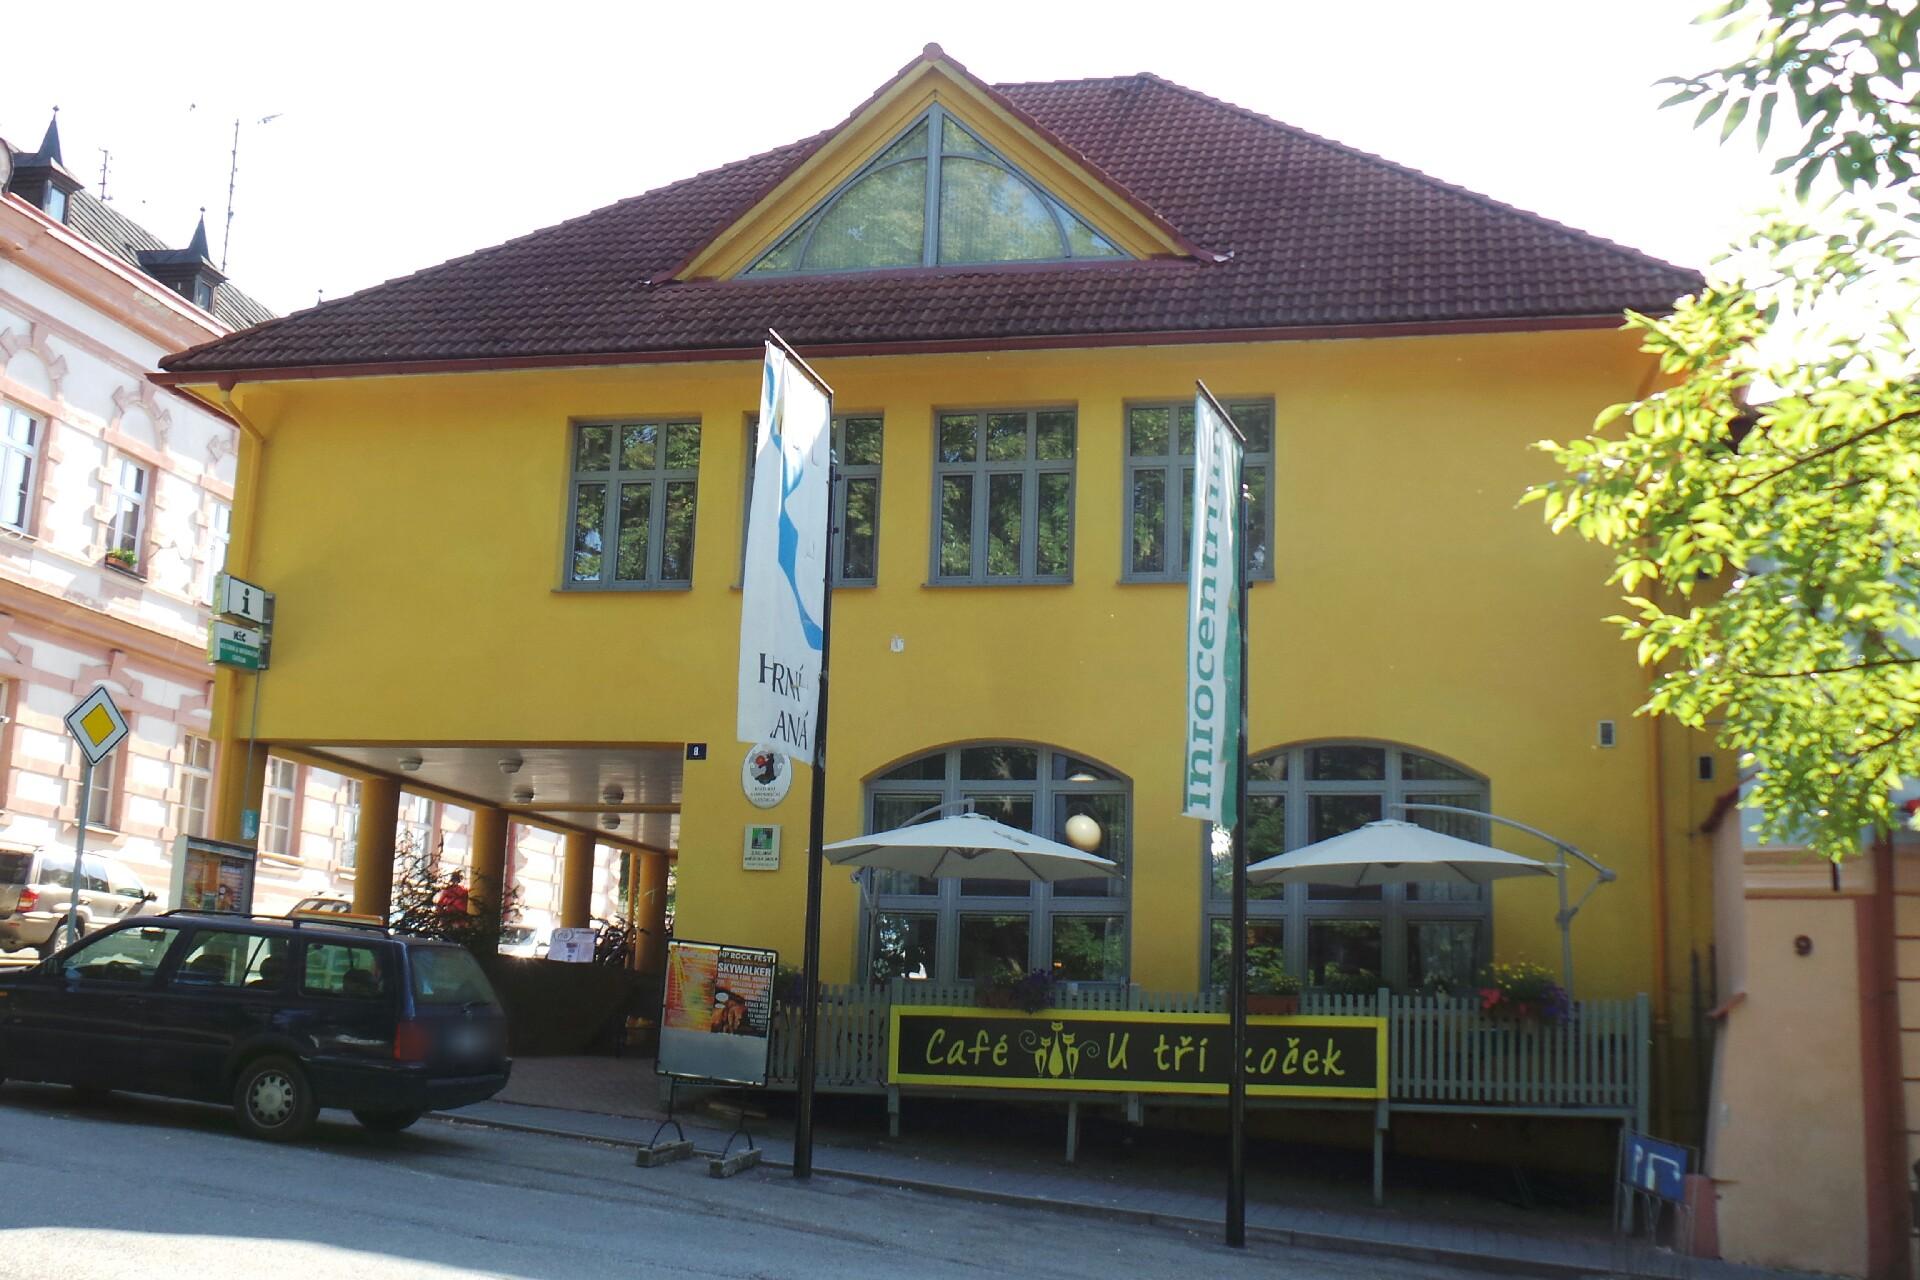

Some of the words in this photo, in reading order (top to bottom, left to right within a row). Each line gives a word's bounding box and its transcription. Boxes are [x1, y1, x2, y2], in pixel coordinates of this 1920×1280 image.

[1794, 934, 1814, 957] 9
[730, 952, 751, 961] ROCK
[753, 954, 772, 963] FEST
[718, 962, 771, 977] SKYWALKER
[925, 1028, 1008, 1067] Café
[1107, 1032, 1129, 1070] U
[1154, 1036, 1208, 1073] tří
